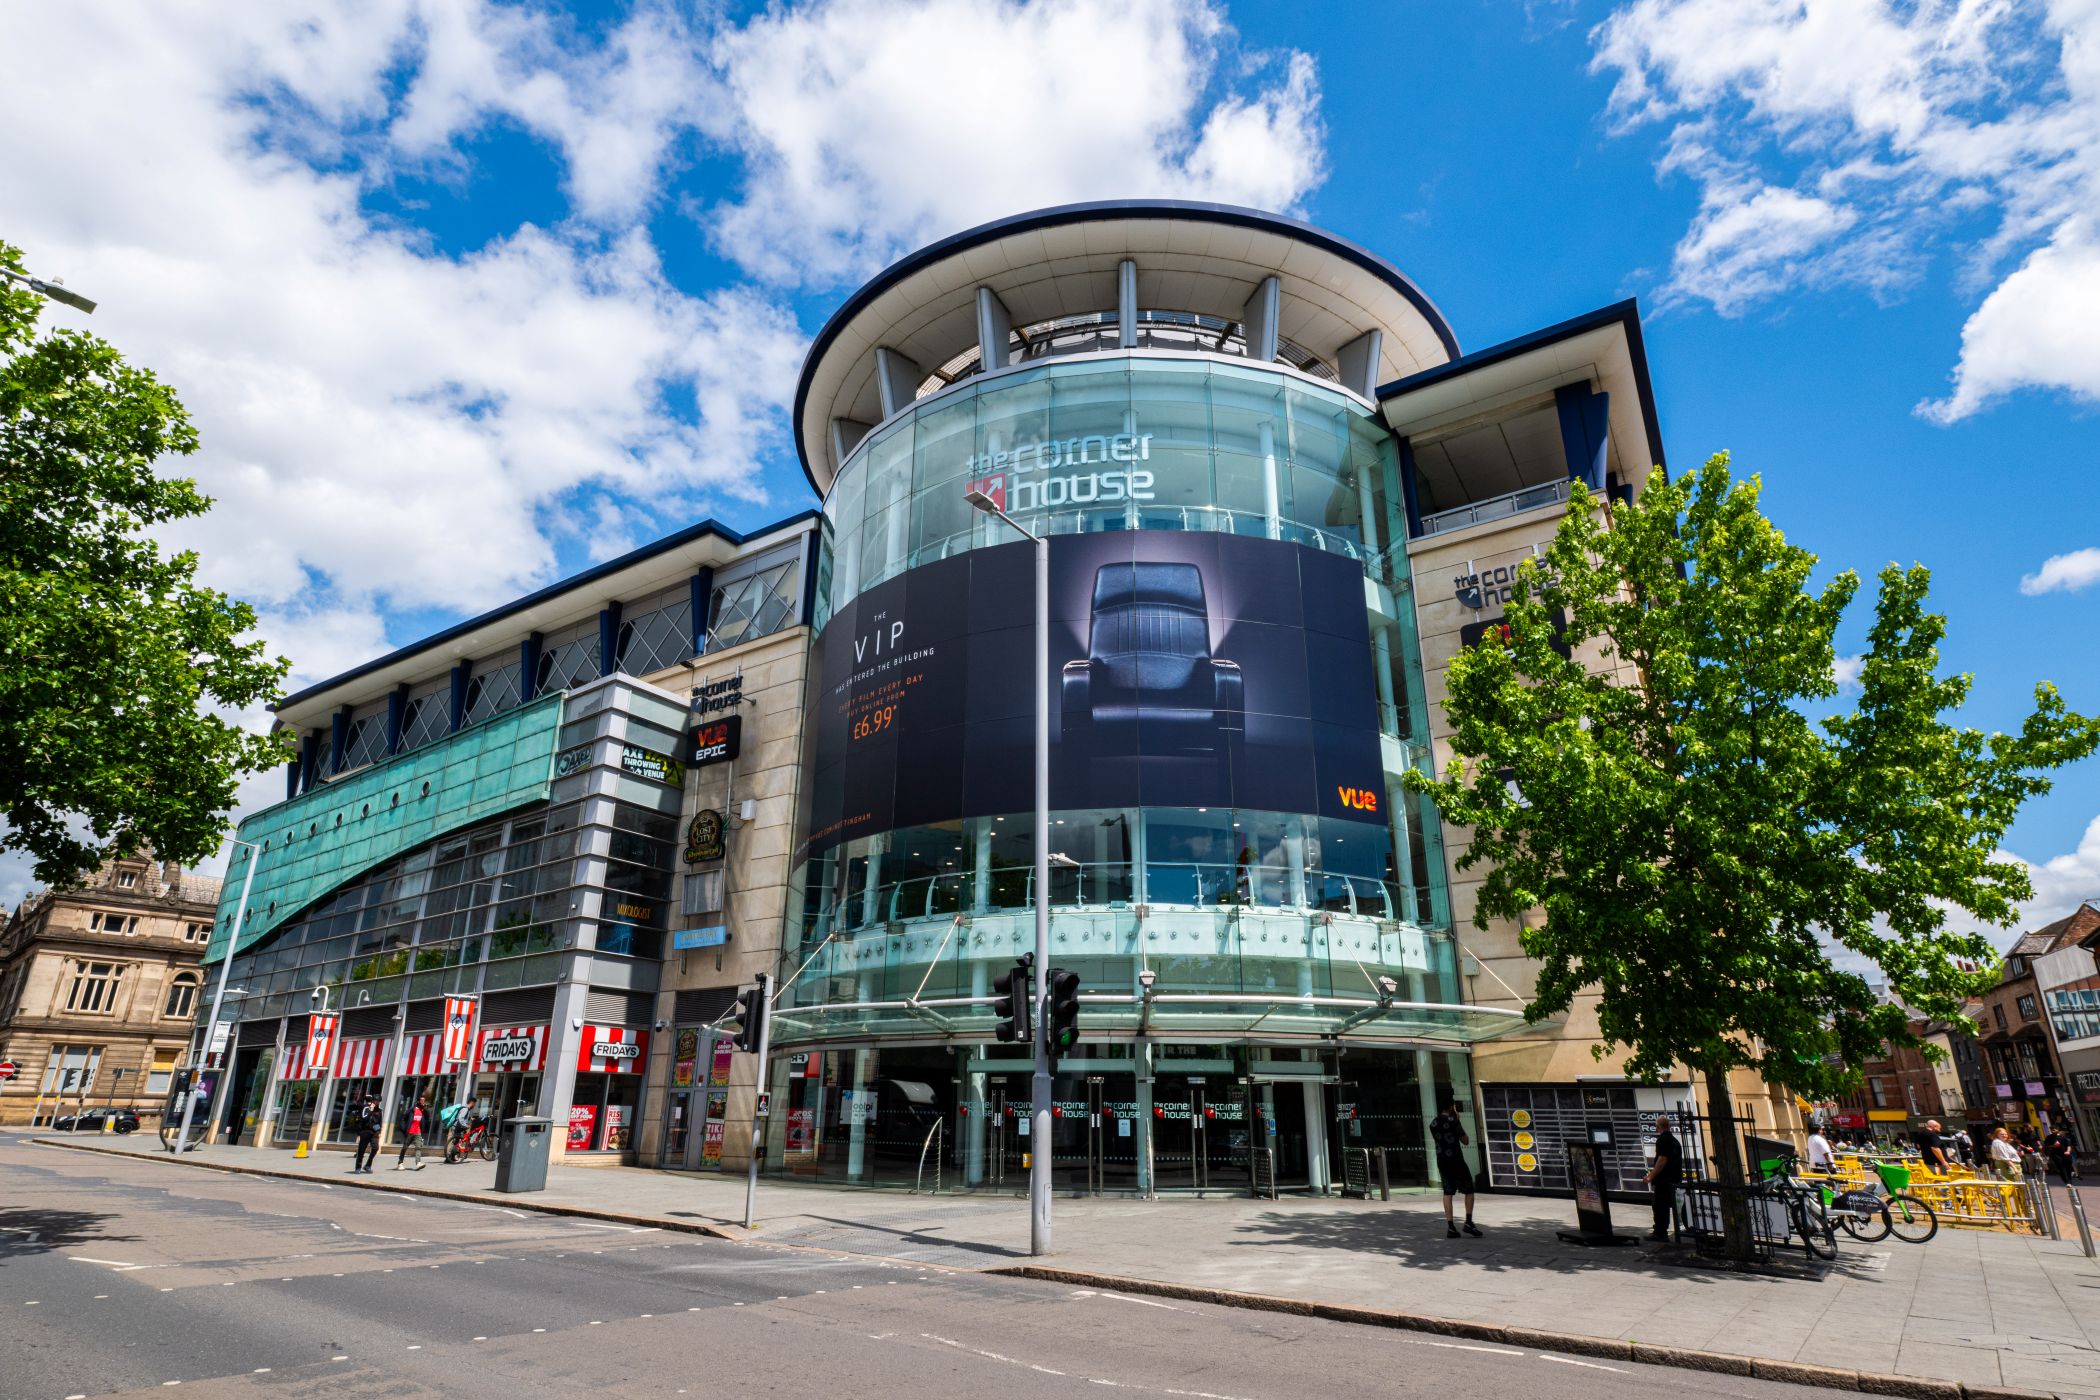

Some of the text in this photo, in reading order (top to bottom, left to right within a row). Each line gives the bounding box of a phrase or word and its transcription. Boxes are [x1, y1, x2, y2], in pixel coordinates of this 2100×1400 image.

[966, 433, 1154, 477] the corner
[1012, 471, 1156, 513] house
[1454, 574, 1479, 589] the
[874, 611, 887, 622] THE
[855, 620, 904, 663] VIP
[835, 647, 935, 695] HAS ENTERED THE BUILDING
[878, 680, 902, 695] EVERY
[906, 674, 923, 685] DAY
[886, 690, 905, 703] FROM
[703, 692, 742, 713] house
[622, 747, 644, 760] AXE
[695, 744, 727, 761] EPIC
[624, 757, 662, 771] THROWING
[643, 769, 666, 780] VENUE
[485, 1041, 528, 1058] FRIDAYS
[596, 1044, 637, 1056] FRIDAYS
[571, 1107, 589, 1115] 20%
[1113, 1102, 1140, 1110] corner
[1163, 1102, 1191, 1111] corner
[1215, 1102, 1242, 1111] corner
[608, 1110, 623, 1118] RISE
[1062, 1109, 1089, 1118] house
[1113, 1110, 1141, 1119] house
[1163, 1110, 1191, 1119] house
[1215, 1111, 1243, 1120] house
[706, 1124, 724, 1133] TIKI
[705, 1133, 723, 1142] BAR
